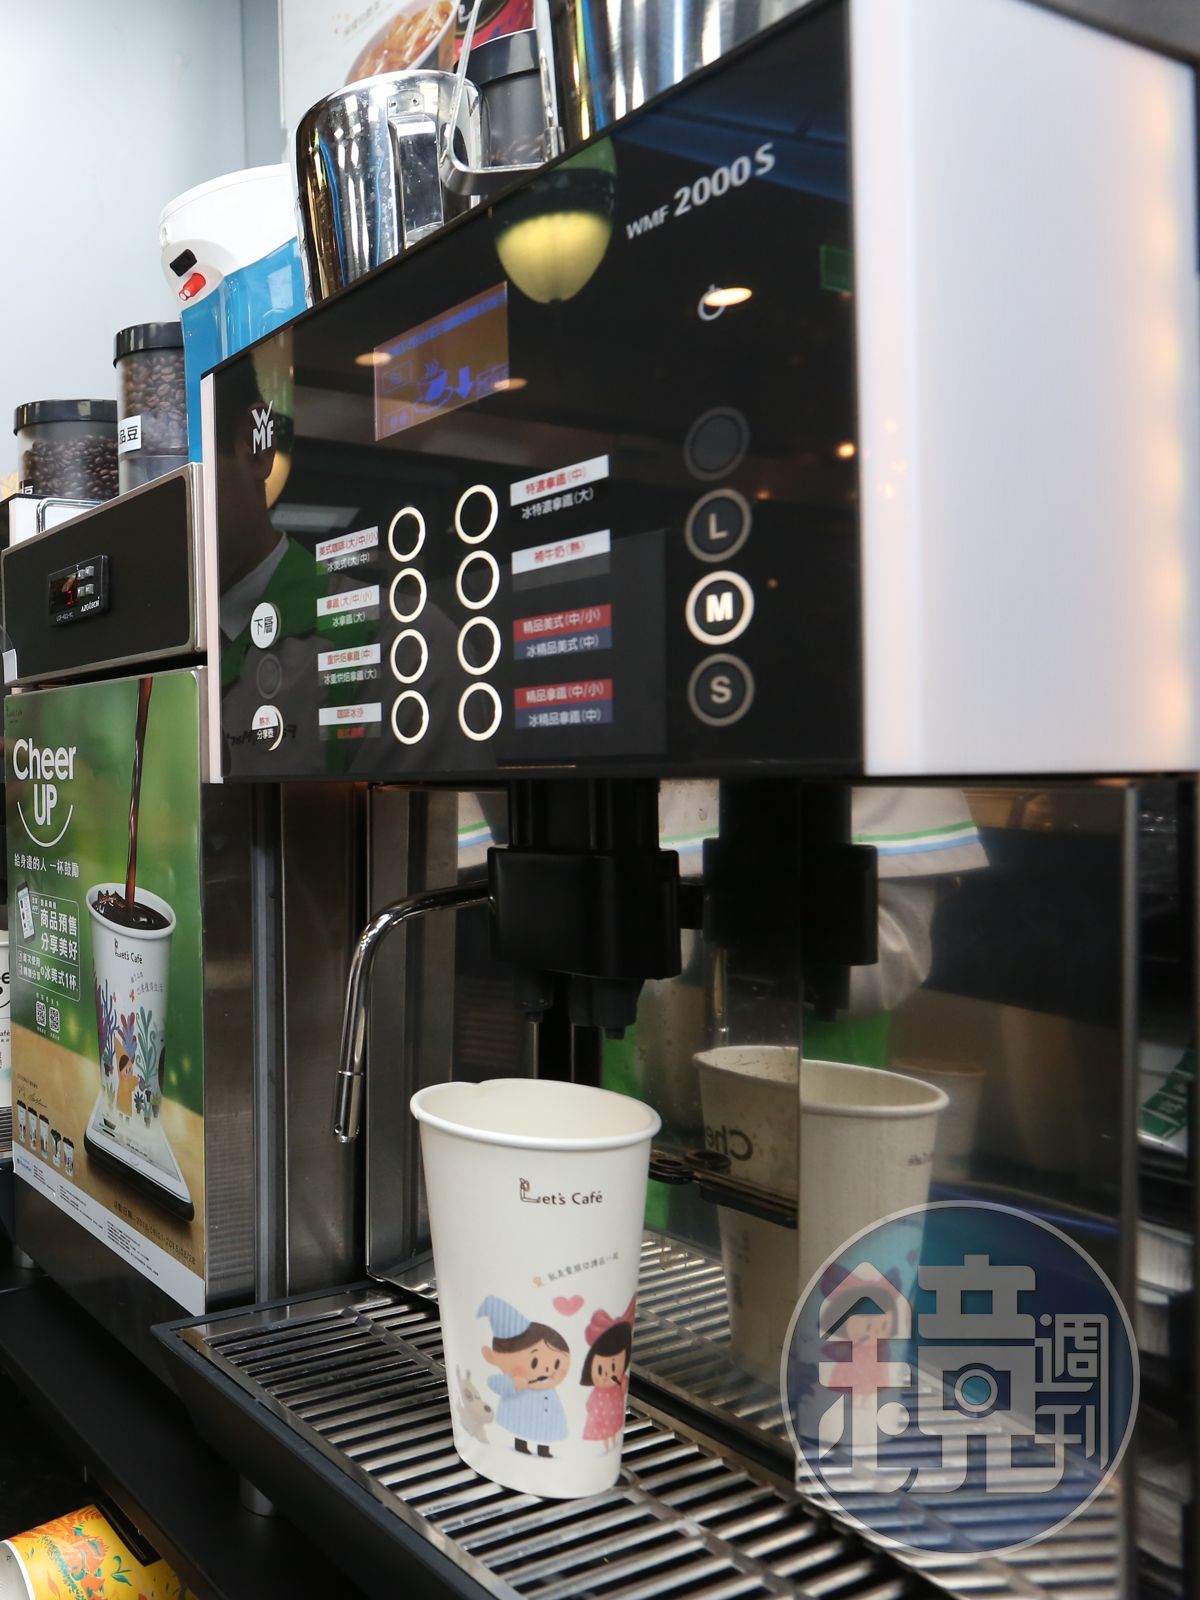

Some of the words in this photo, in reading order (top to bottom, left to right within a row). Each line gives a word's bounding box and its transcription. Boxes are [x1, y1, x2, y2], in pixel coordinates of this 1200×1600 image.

[626, 204, 670, 240] WMF
[708, 512, 729, 540] L
[706, 591, 734, 623] M
[253, 615, 274, 635] 下層
[709, 675, 733, 704] S
[12, 737, 77, 781] Cheer
[33, 783, 58, 826] UP
[40, 908, 78, 938] 商品預售
[41, 932, 78, 961] 分享美好
[571, 1190, 603, 1206] Café
